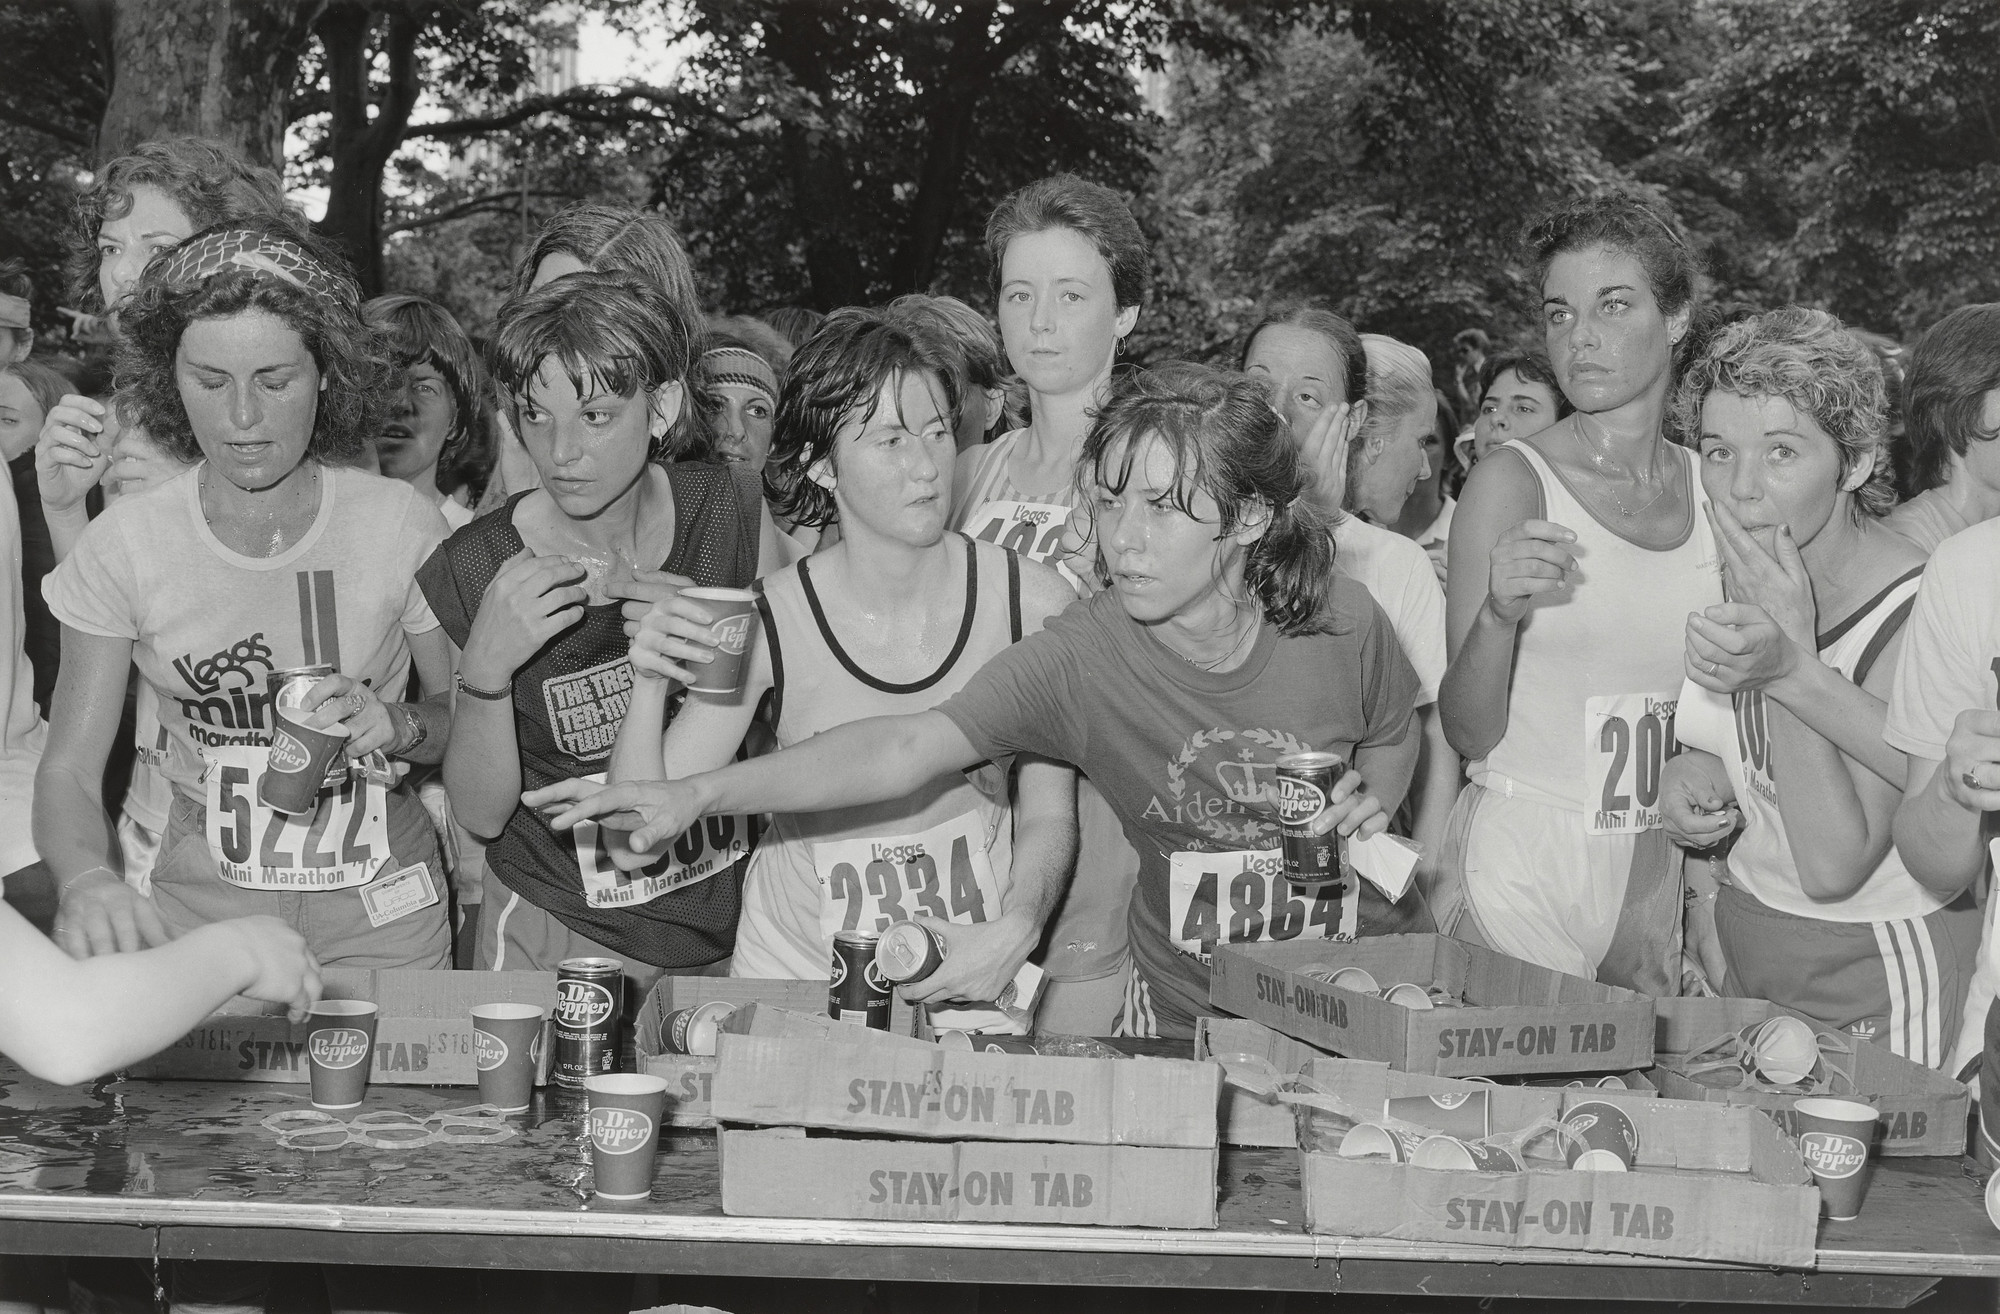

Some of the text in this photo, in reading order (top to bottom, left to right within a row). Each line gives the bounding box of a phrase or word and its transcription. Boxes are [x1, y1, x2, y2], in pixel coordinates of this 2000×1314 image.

[1012, 504, 1051, 524] L'eggs
[172, 633, 275, 696] L'eggs
[551, 677, 595, 711] THE
[556, 687, 632, 734] TEN-MI
[270, 747, 307, 768] pper
[274, 733, 298, 754] Dr
[1280, 780, 1305, 801] Dr
[219, 765, 372, 869] 5222
[1279, 798, 1321, 819] pper
[1594, 809, 1627, 830] Mini
[871, 843, 926, 866] L'eggs
[1242, 854, 1283, 876] L'eg
[219, 861, 253, 883] Mini
[261, 865, 345, 885] Marathon
[595, 884, 635, 904] Mini
[643, 858, 714, 898] Marathon
[829, 834, 987, 934] 2334
[1181, 871, 1344, 954] 4864
[565, 984, 596, 1003] Dr
[1256, 972, 1349, 1030] STAY-ON TAB
[313, 1038, 367, 1063] Pepper
[331, 1031, 358, 1046] Dr
[474, 1031, 491, 1049] Dr
[1437, 1022, 1617, 1059] STAY-ON TAB
[238, 1040, 309, 1072] STAY-
[375, 1042, 429, 1072] TAB
[846, 1078, 995, 1122] STAY-ON
[1012, 1088, 1075, 1126] TAB
[592, 1116, 648, 1147] Pepper
[604, 1111, 634, 1129] Dr
[1878, 1110, 1928, 1140] TAB
[1804, 1139, 1864, 1172] Pepper
[1821, 1135, 1854, 1154] Dr
[868, 1169, 1094, 1208] STAY-ON TAB
[1445, 1197, 1675, 1241] STAY-ON TAB
